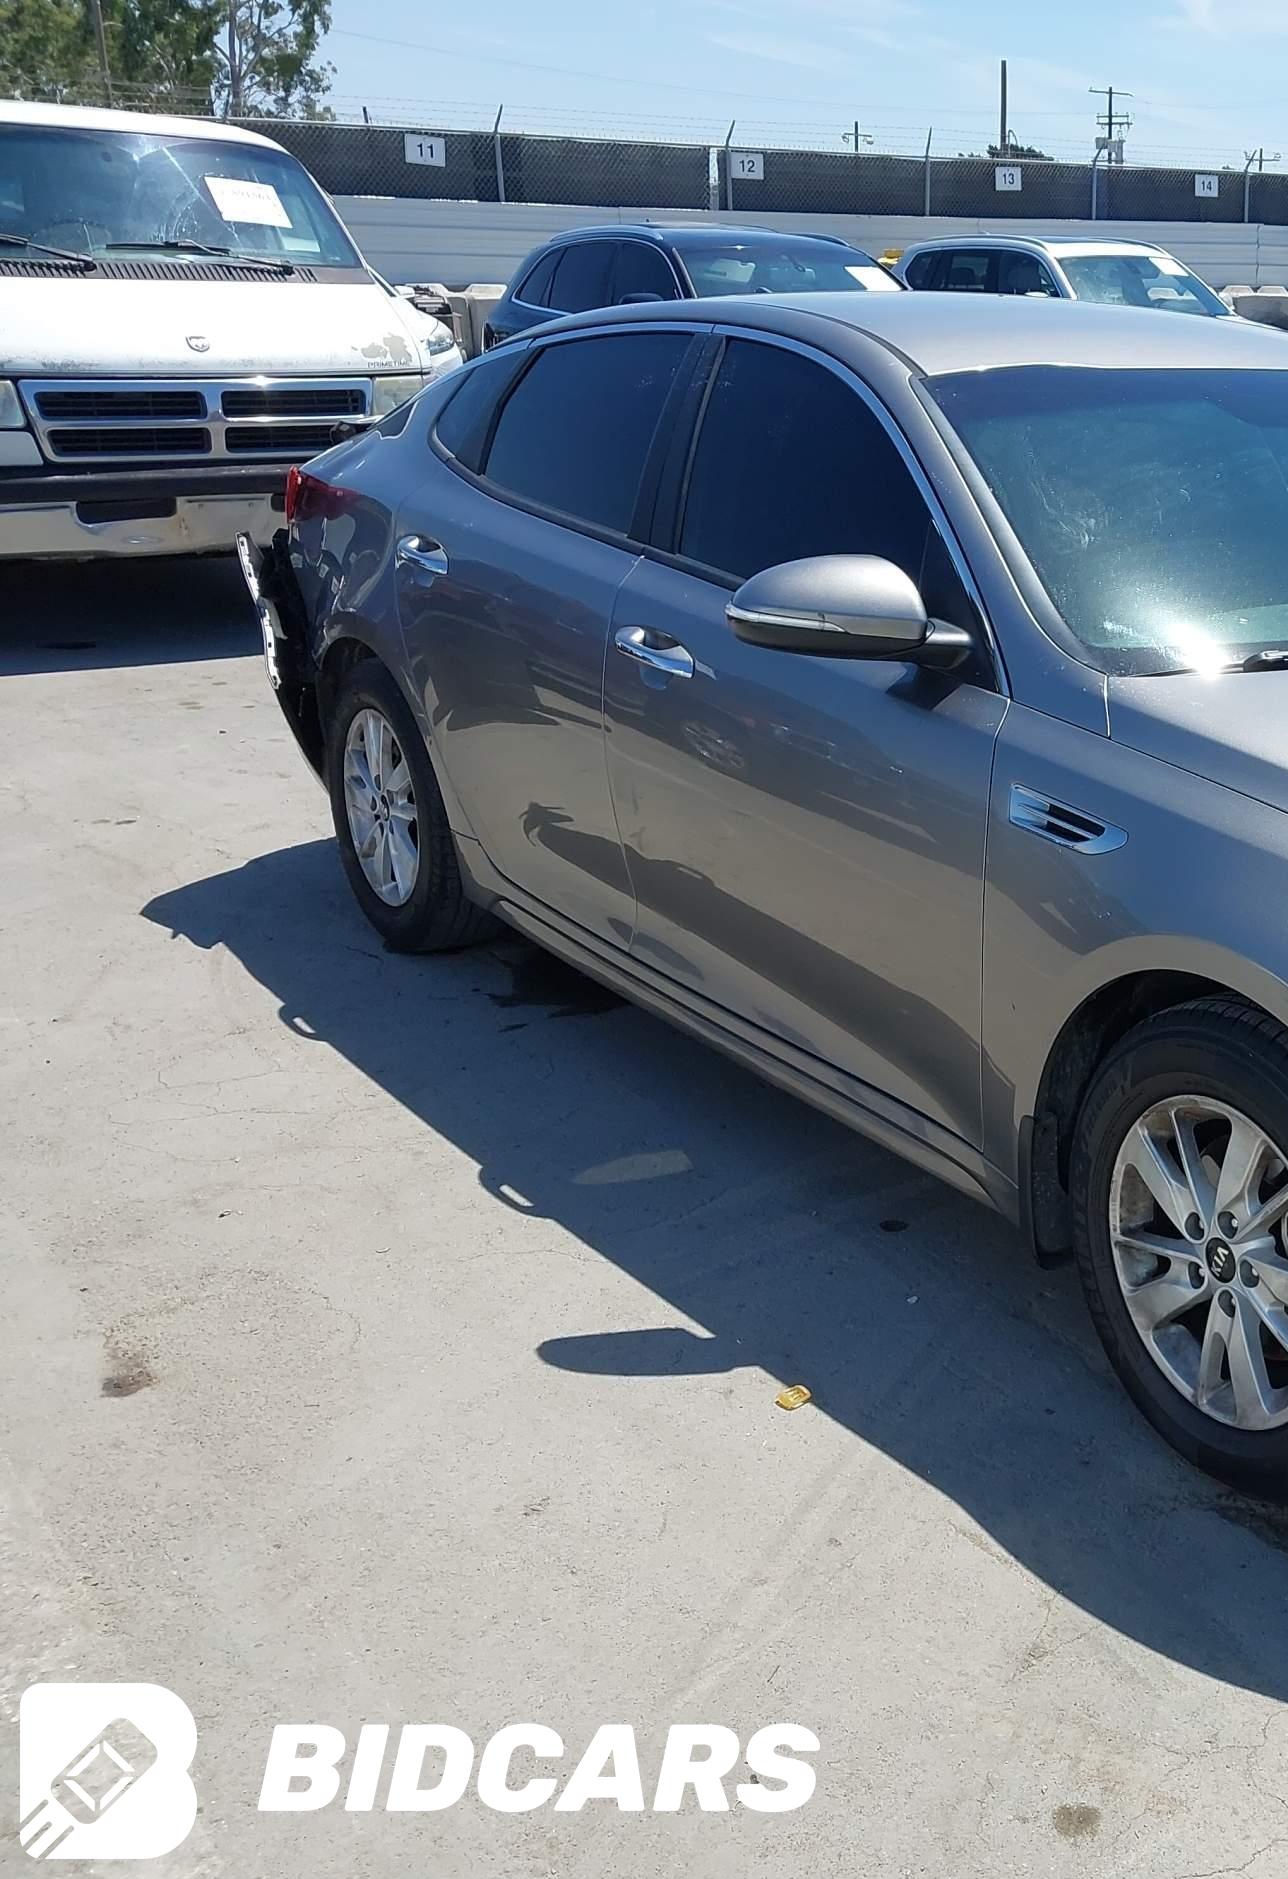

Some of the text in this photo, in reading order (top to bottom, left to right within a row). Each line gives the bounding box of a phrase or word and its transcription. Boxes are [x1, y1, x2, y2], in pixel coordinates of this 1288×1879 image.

[417, 143, 434, 158] 11
[739, 160, 755, 172] 12
[1003, 173, 1015, 185] 13
[1202, 180, 1212, 192] 14
